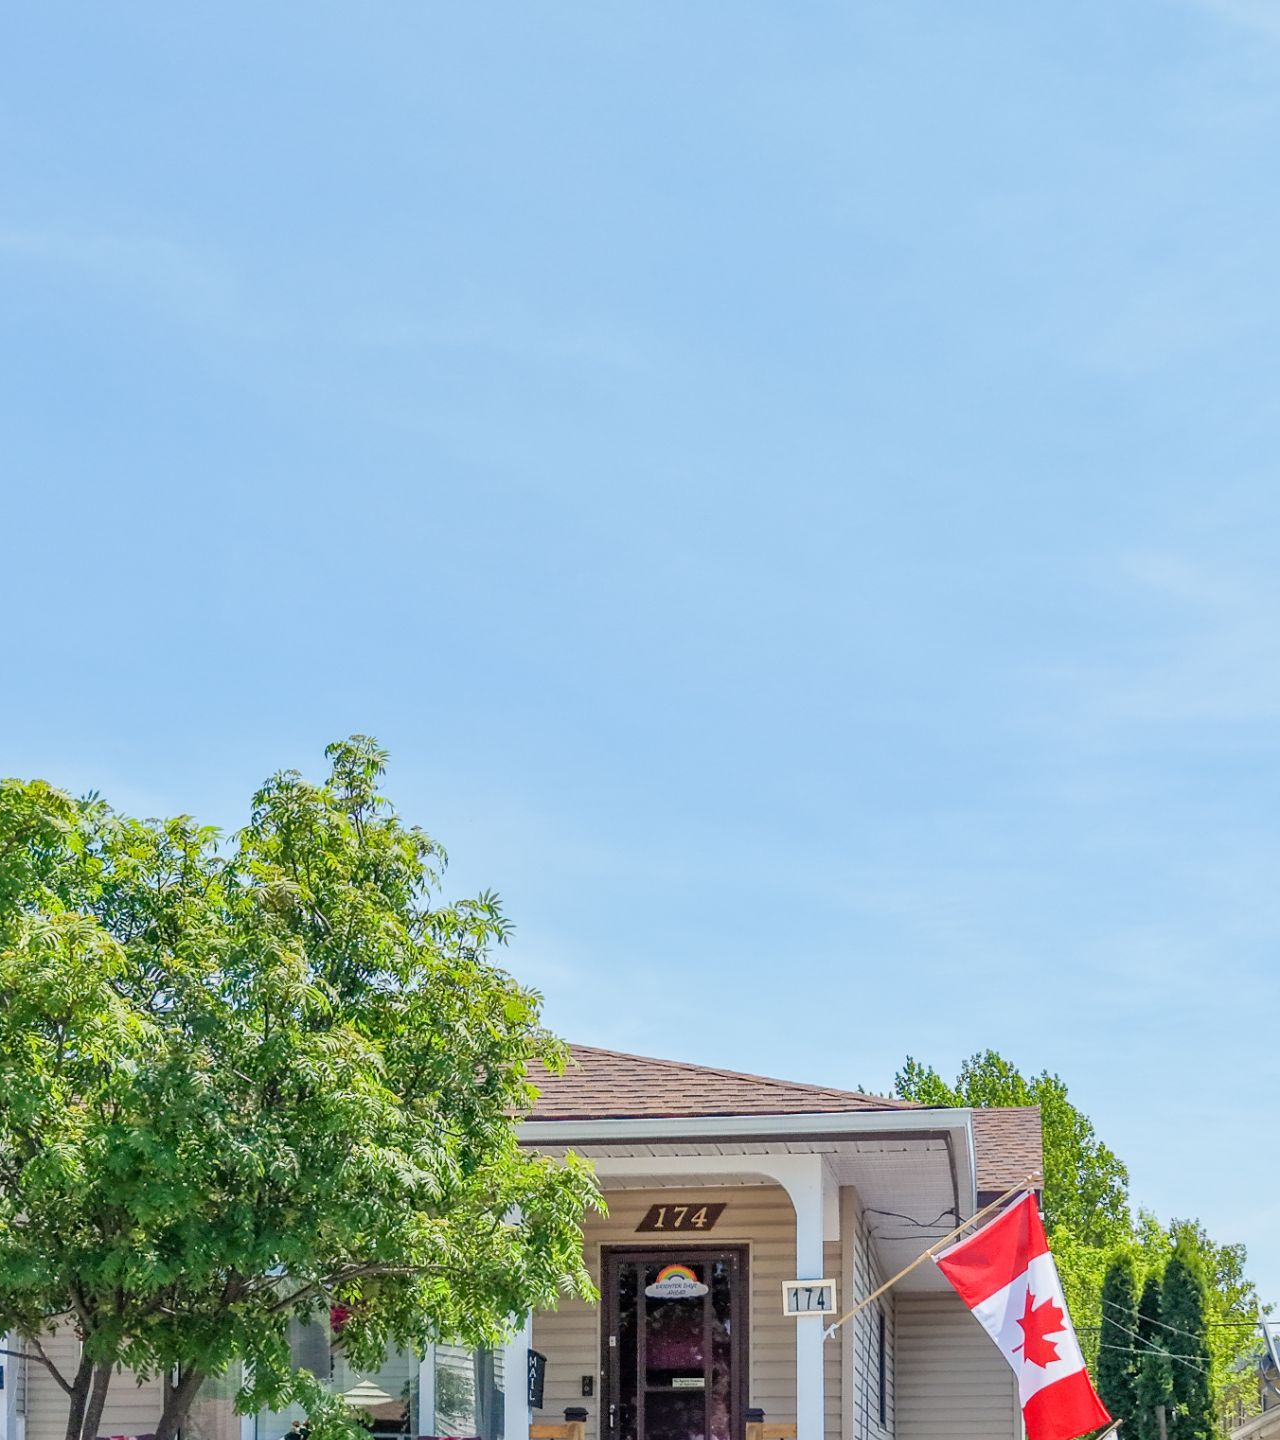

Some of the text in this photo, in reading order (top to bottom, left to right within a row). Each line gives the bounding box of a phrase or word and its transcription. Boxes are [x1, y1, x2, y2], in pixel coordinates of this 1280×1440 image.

[654, 1206, 708, 1228] 174
[792, 1287, 825, 1312] 174
[529, 1355, 537, 1401] MAIL
